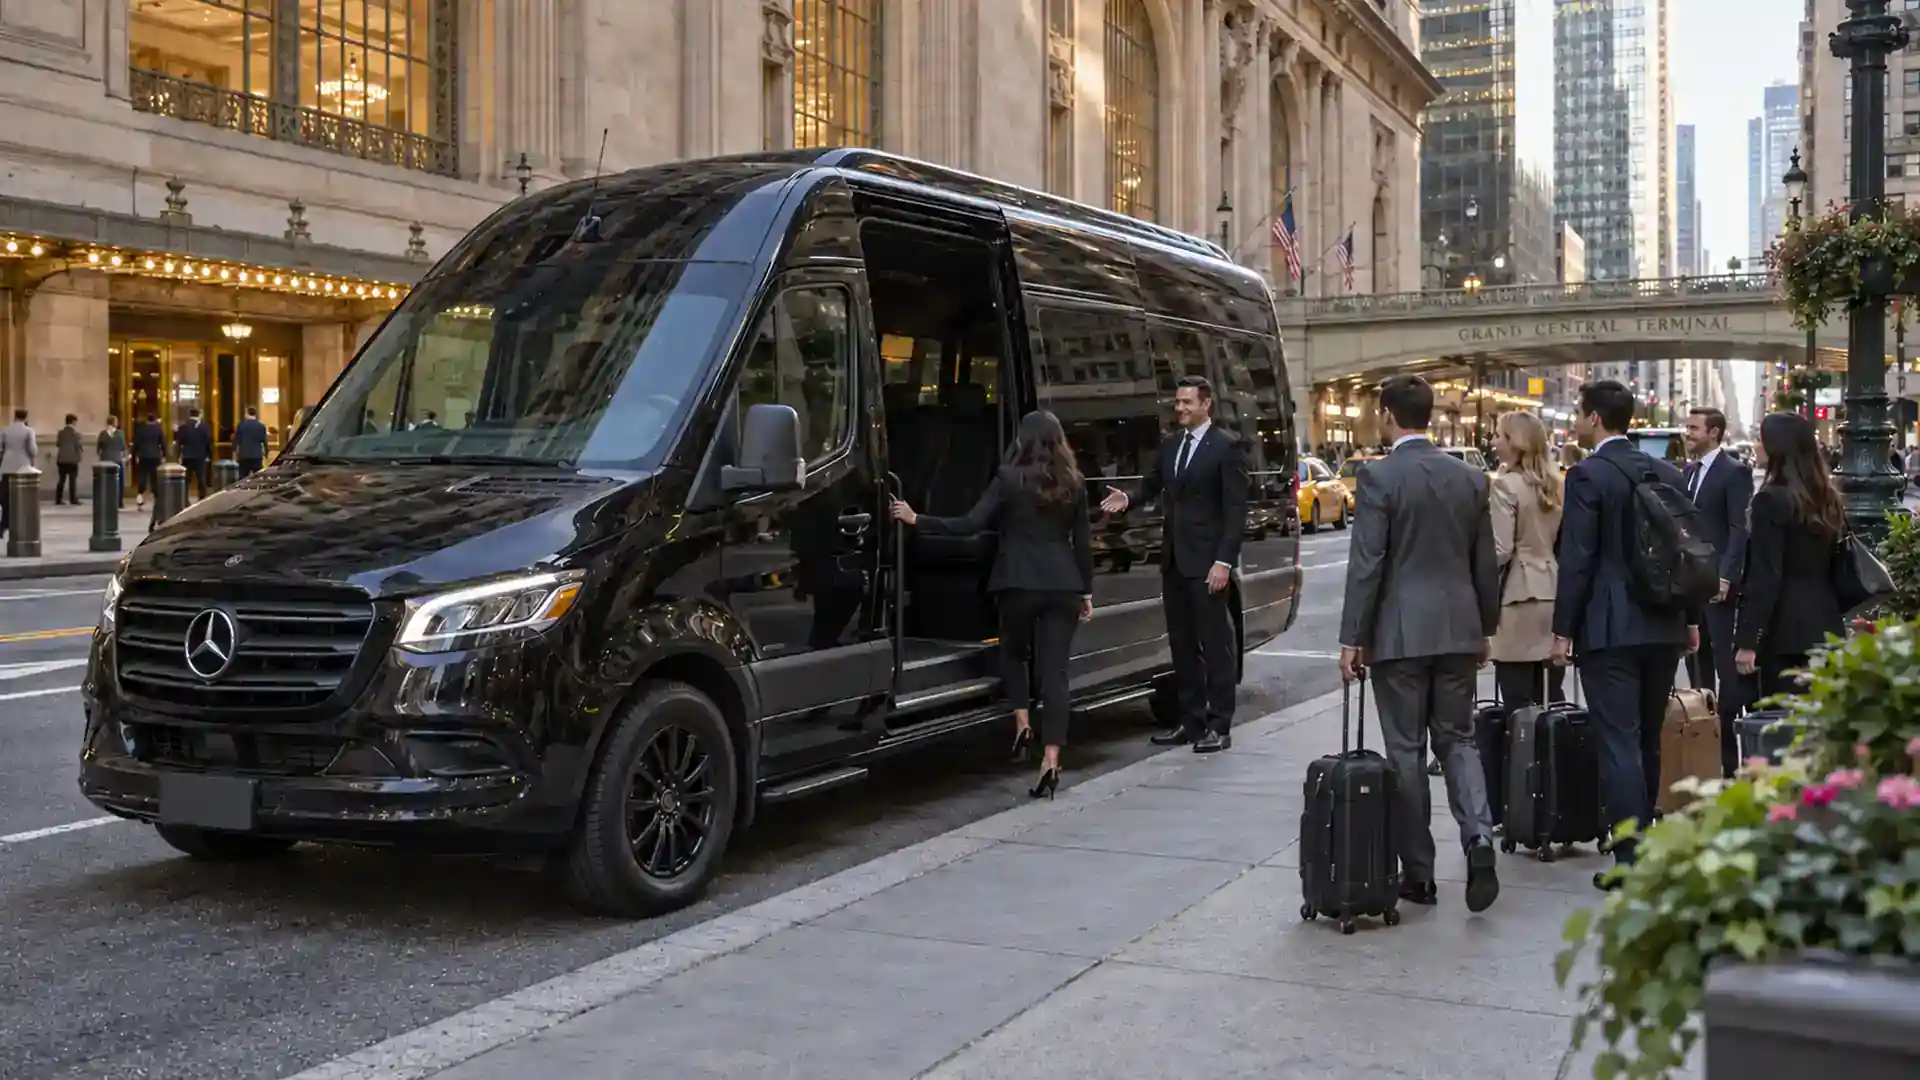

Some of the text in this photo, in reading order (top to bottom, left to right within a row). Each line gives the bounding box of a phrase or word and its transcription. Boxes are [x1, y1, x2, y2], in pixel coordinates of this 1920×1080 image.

[1458, 316, 1733, 342] GRAND CENTRAL TERMINAL
